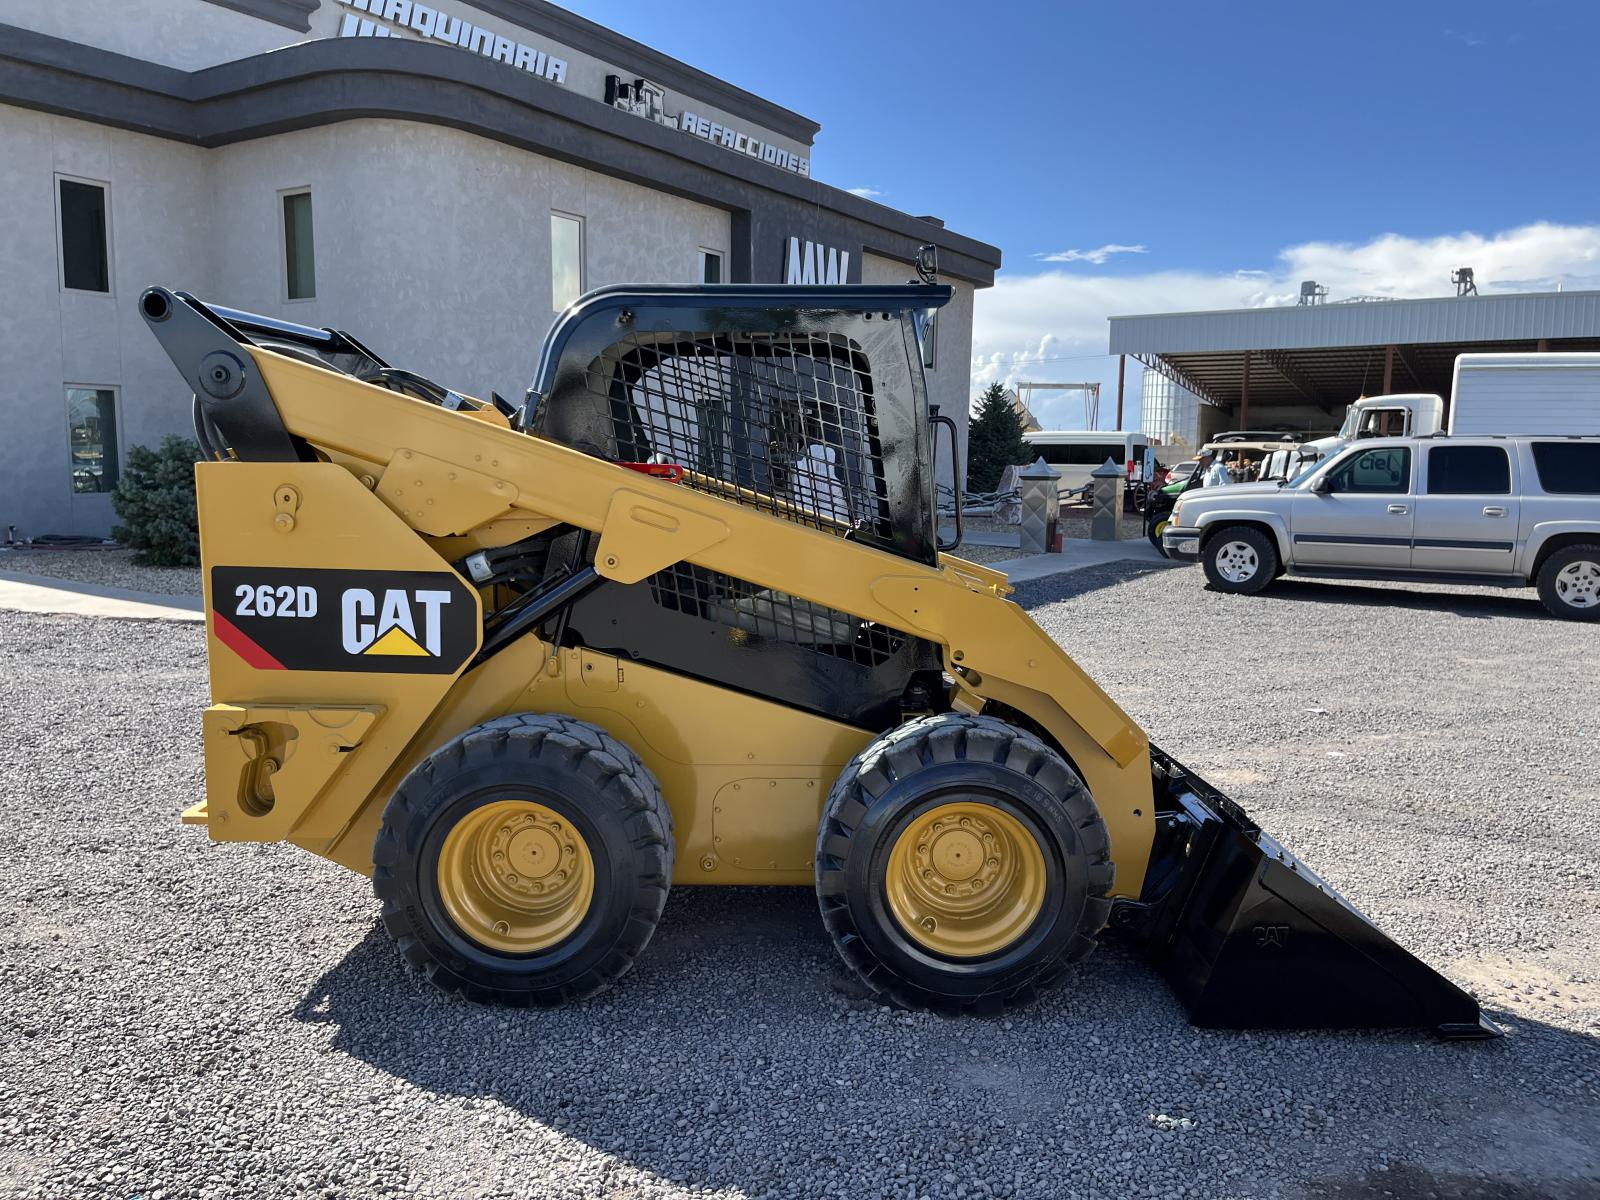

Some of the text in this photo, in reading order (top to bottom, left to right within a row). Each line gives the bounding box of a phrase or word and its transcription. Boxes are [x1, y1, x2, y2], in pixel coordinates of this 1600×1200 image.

[681, 111, 810, 177] REFACCIONES
[235, 584, 318, 618] 262D
[341, 588, 451, 657] CAT
[1251, 926, 1290, 948] CAT
